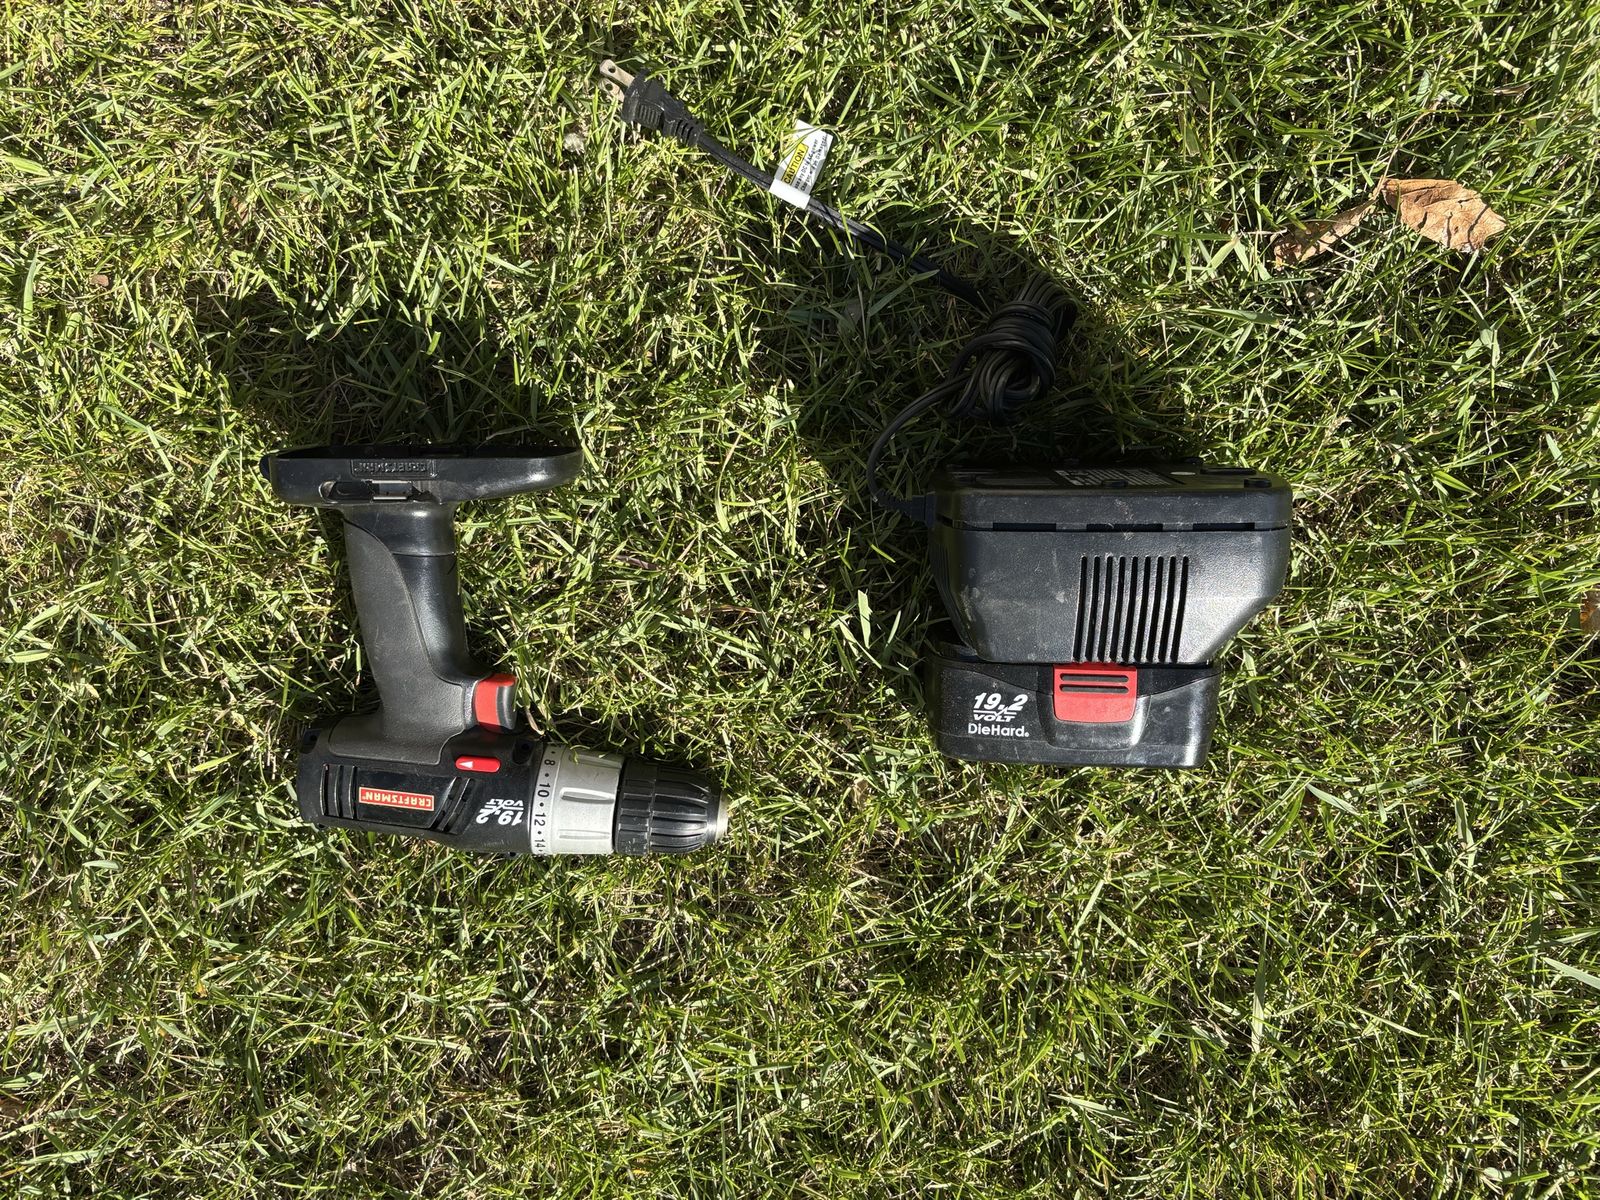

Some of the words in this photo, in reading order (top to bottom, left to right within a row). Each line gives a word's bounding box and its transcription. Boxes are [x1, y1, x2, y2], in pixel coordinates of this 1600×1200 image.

[784, 149, 805, 185] CAUTION
[972, 692, 1029, 711] 19.2
[973, 713, 1016, 722] VOLT
[537, 783, 551, 798] 10
[486, 798, 524, 807] VOLT
[475, 808, 524, 826] 19.2
[533, 812, 547, 827] 12
[534, 838, 547, 848] 14
